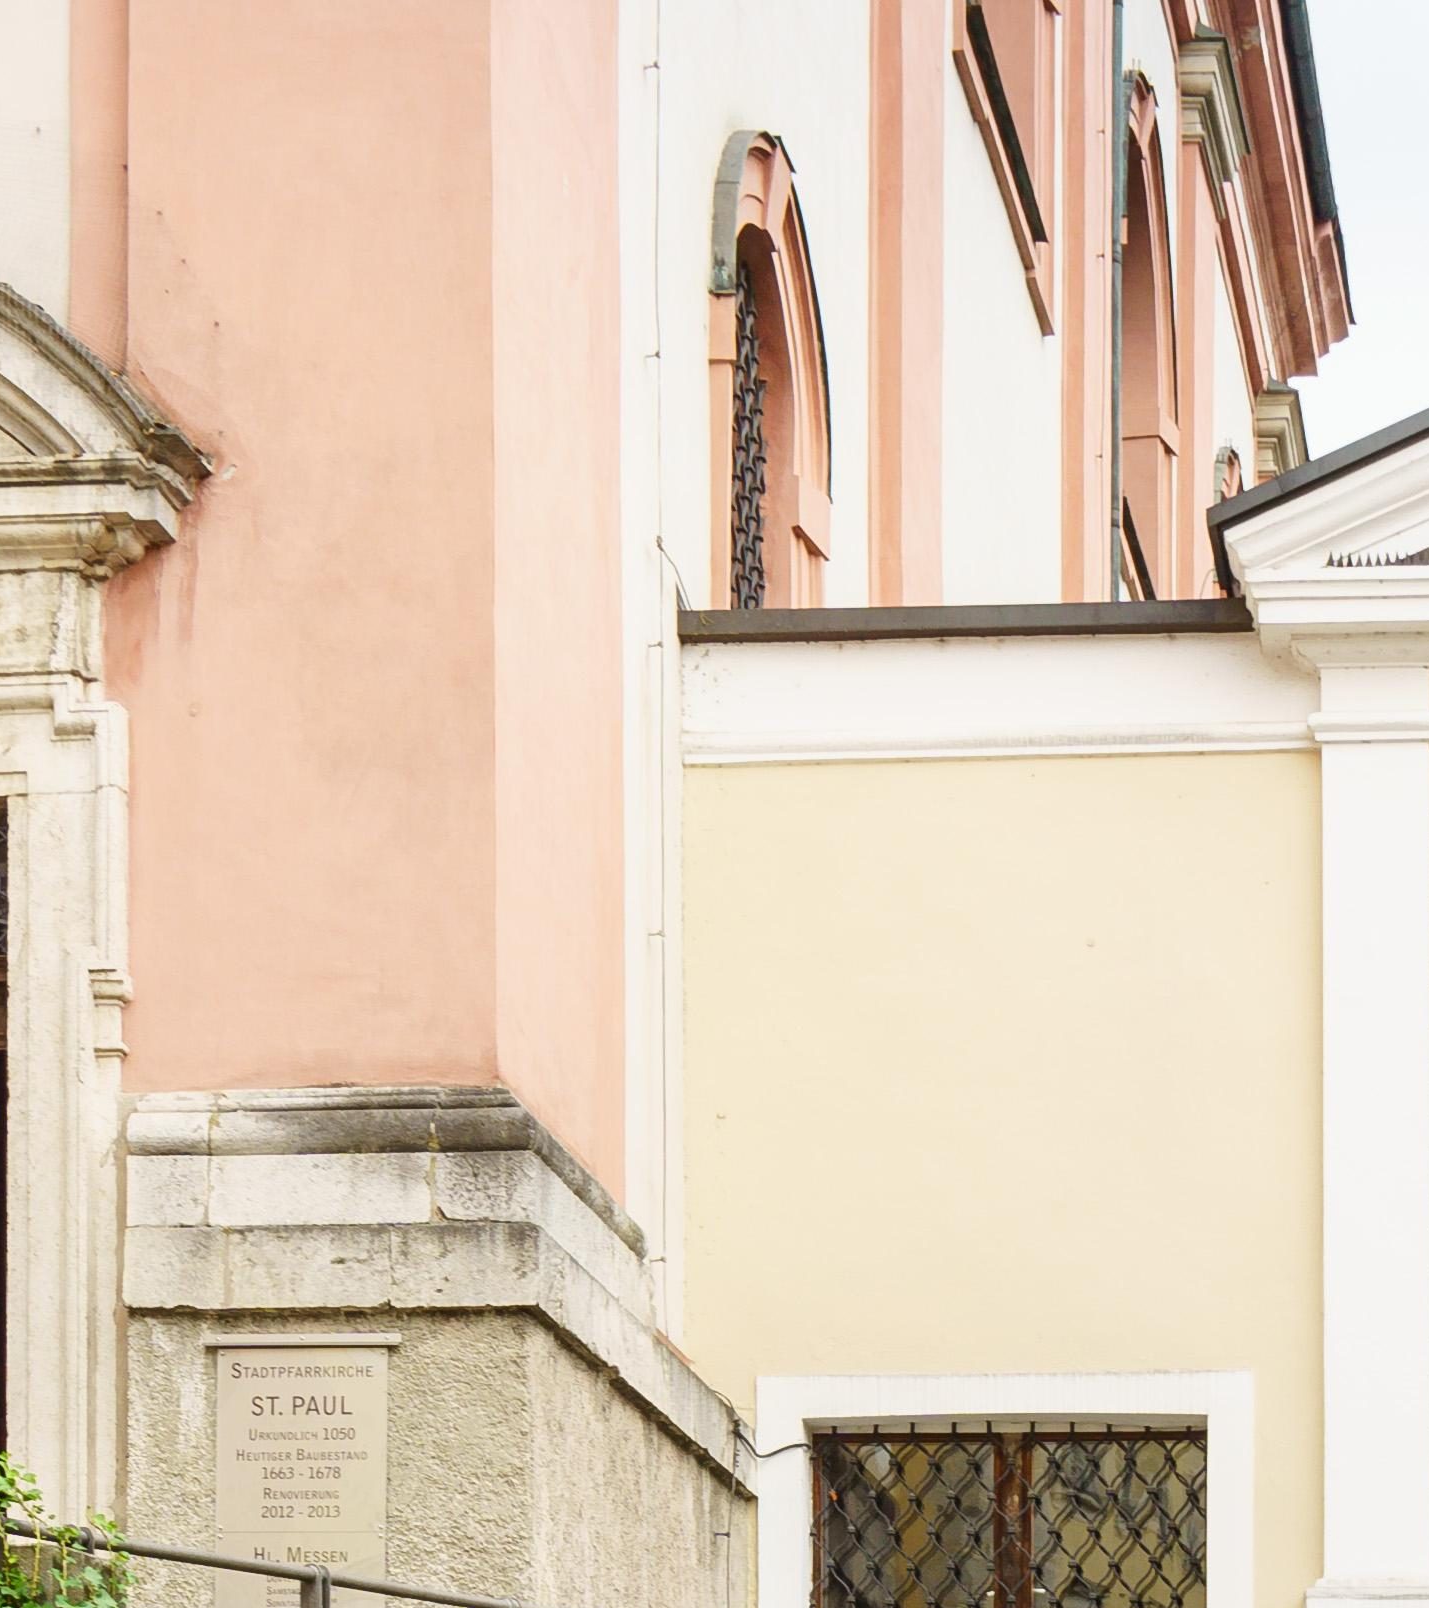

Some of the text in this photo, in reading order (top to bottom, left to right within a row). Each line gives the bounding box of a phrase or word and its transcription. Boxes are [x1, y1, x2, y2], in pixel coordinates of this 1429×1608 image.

[231, 1362, 374, 1379] STADTPFARRKIRCHE
[251, 1396, 353, 1416] ST. PAUL
[248, 1427, 356, 1441] URKUNDLICH 1050
[236, 1448, 369, 1461] HEUTIGER BAUBESTAND
[261, 1466, 294, 1480] 1663
[308, 1466, 342, 1479] 1678
[263, 1487, 340, 1499] RENOVIERUNG
[261, 1505, 294, 1518] 2012
[307, 1505, 341, 1518] 2013
[254, 1547, 349, 1563] HL. MESSEN
